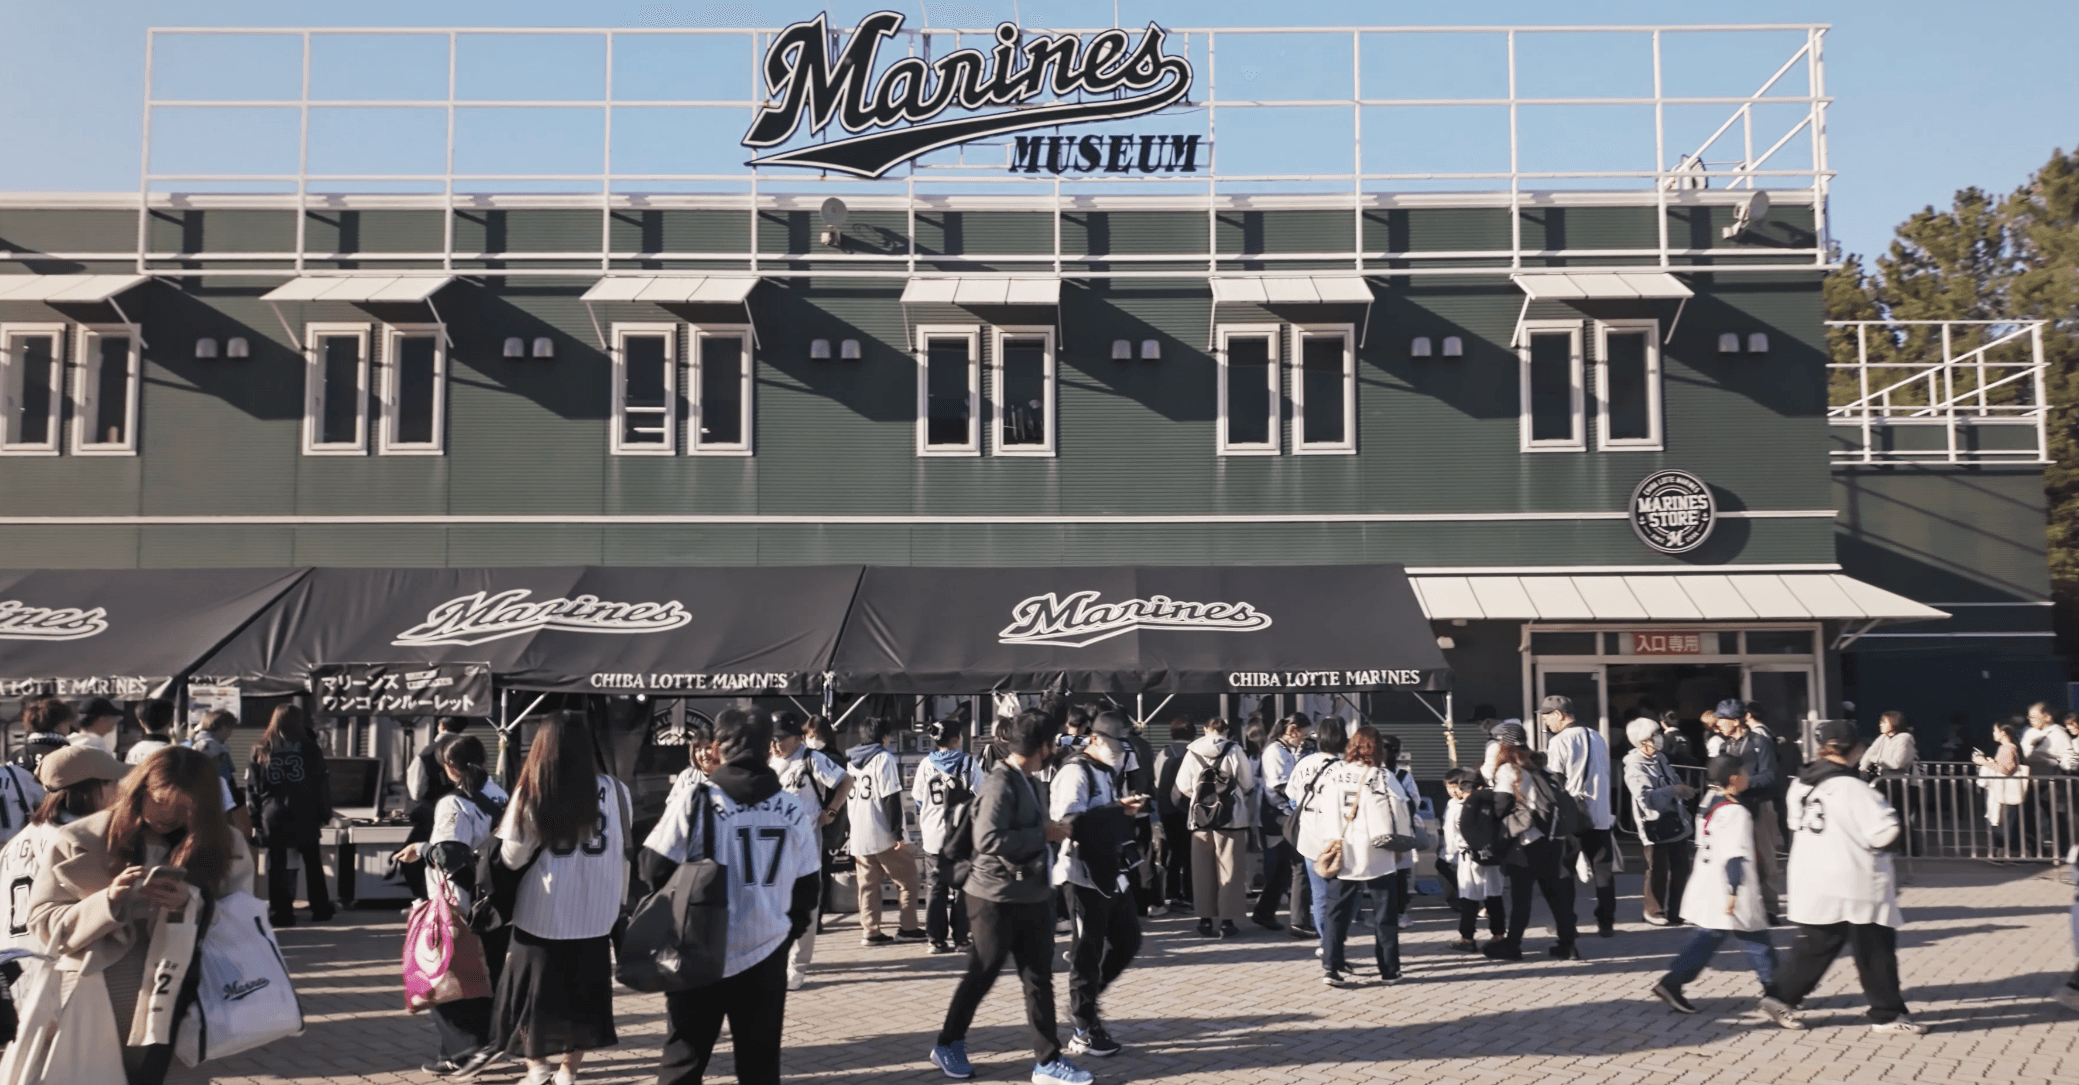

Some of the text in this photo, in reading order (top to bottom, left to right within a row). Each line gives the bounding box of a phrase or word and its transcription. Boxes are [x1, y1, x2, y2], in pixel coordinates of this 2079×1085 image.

[741, 10, 1193, 179] Marines
[1008, 135, 1202, 173] MUSEUM
[1638, 494, 1709, 513] MARINES
[1649, 510, 1699, 528] STORE
[0, 600, 109, 641] ines
[391, 589, 693, 646] Marines
[998, 590, 1273, 648] Marines
[1636, 635, 1699, 651] 入口専用
[10, 681, 67, 696] LOTTE
[71, 677, 148, 695] MARINES
[320, 673, 400, 691] マリーンズ
[590, 672, 789, 690] CHIBA LOTTE MARINES
[1229, 669, 1421, 687] CHIBA LOTTE MARINES
[322, 694, 475, 712] ワンコインルーレット
[266, 754, 306, 785] 63
[1343, 790, 1359, 822] 5
[734, 824, 789, 887] 17
[156, 973, 173, 995] 2
